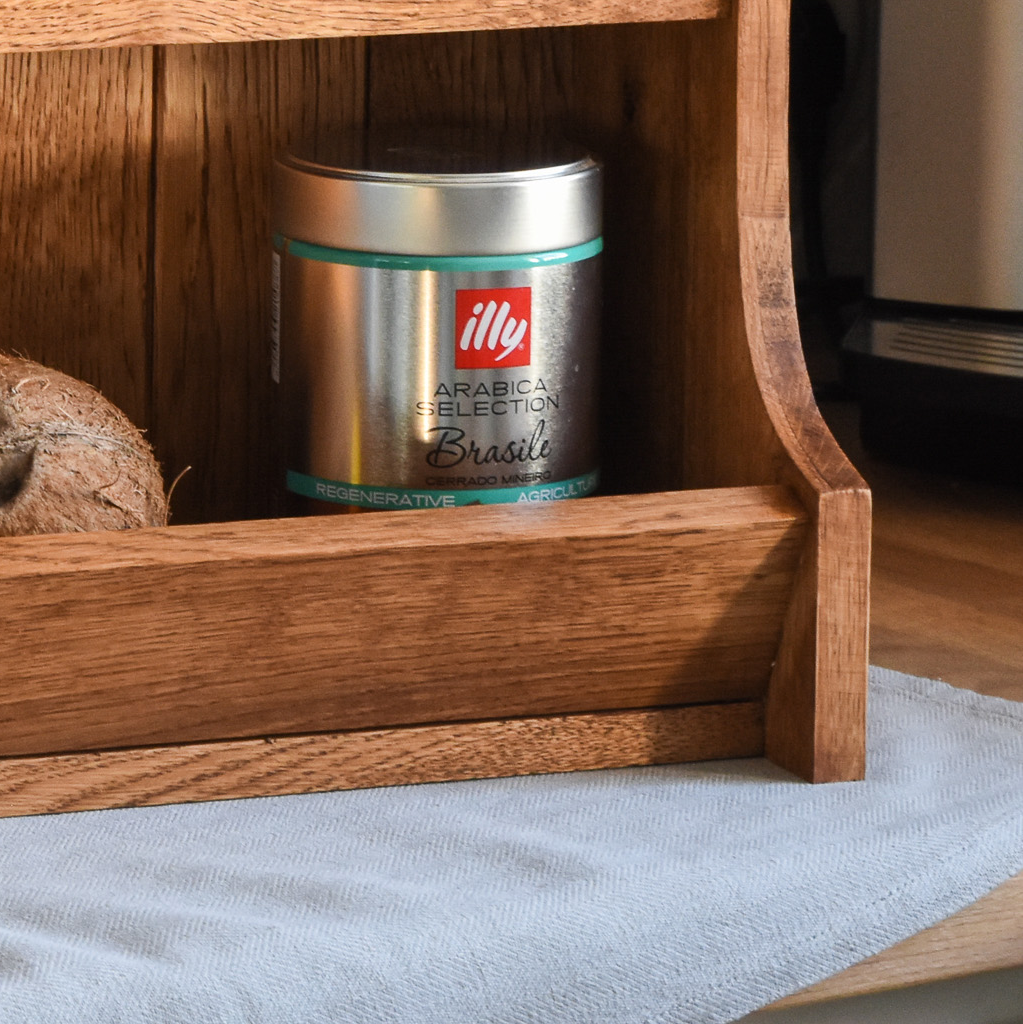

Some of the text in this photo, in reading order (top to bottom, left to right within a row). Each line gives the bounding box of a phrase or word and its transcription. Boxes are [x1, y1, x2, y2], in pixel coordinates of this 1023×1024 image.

[460, 300, 528, 362] illy
[434, 378, 548, 398] ARABICA
[416, 394, 559, 417] SELECTION
[426, 419, 552, 469] Brasile
[426, 470, 552, 488] CERRADO MINEIRO
[315, 483, 456, 508] REGENERATIVE
